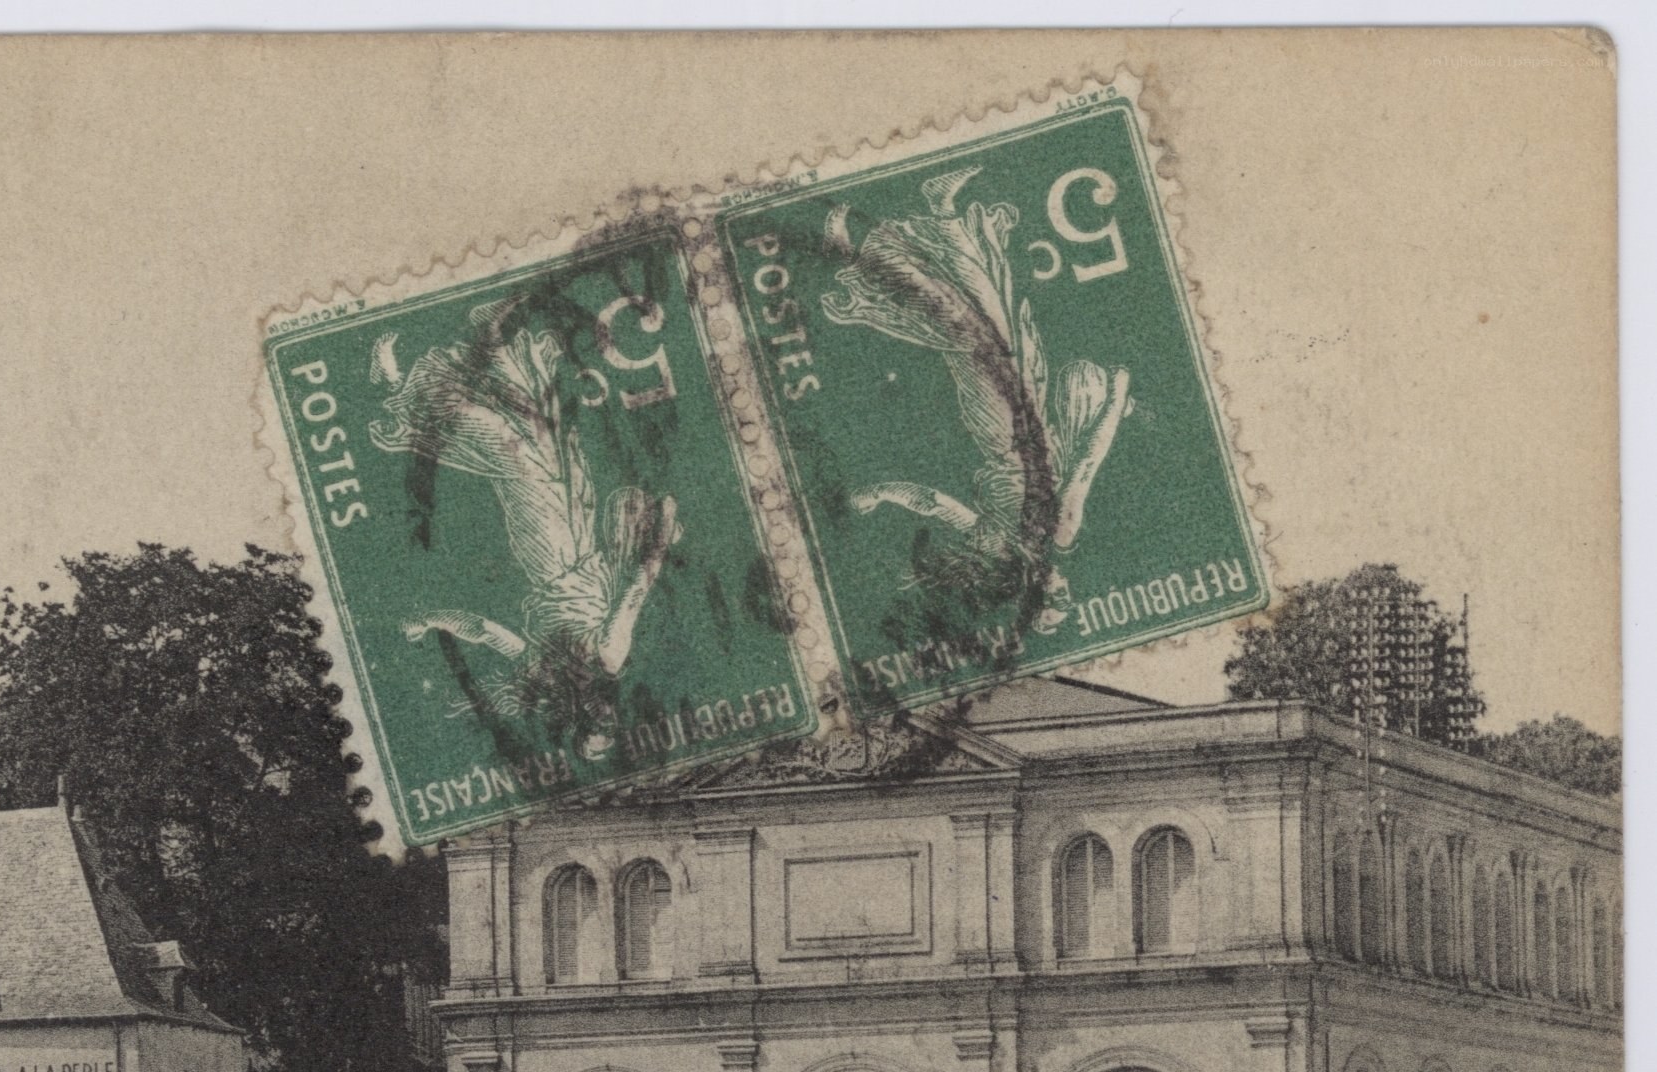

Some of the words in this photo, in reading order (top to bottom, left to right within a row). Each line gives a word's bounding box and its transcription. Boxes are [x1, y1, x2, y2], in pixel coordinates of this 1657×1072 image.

[749, 231, 821, 402] POSTES
[291, 360, 369, 531] POSTES
[412, 742, 570, 823] FRANÇAISE
